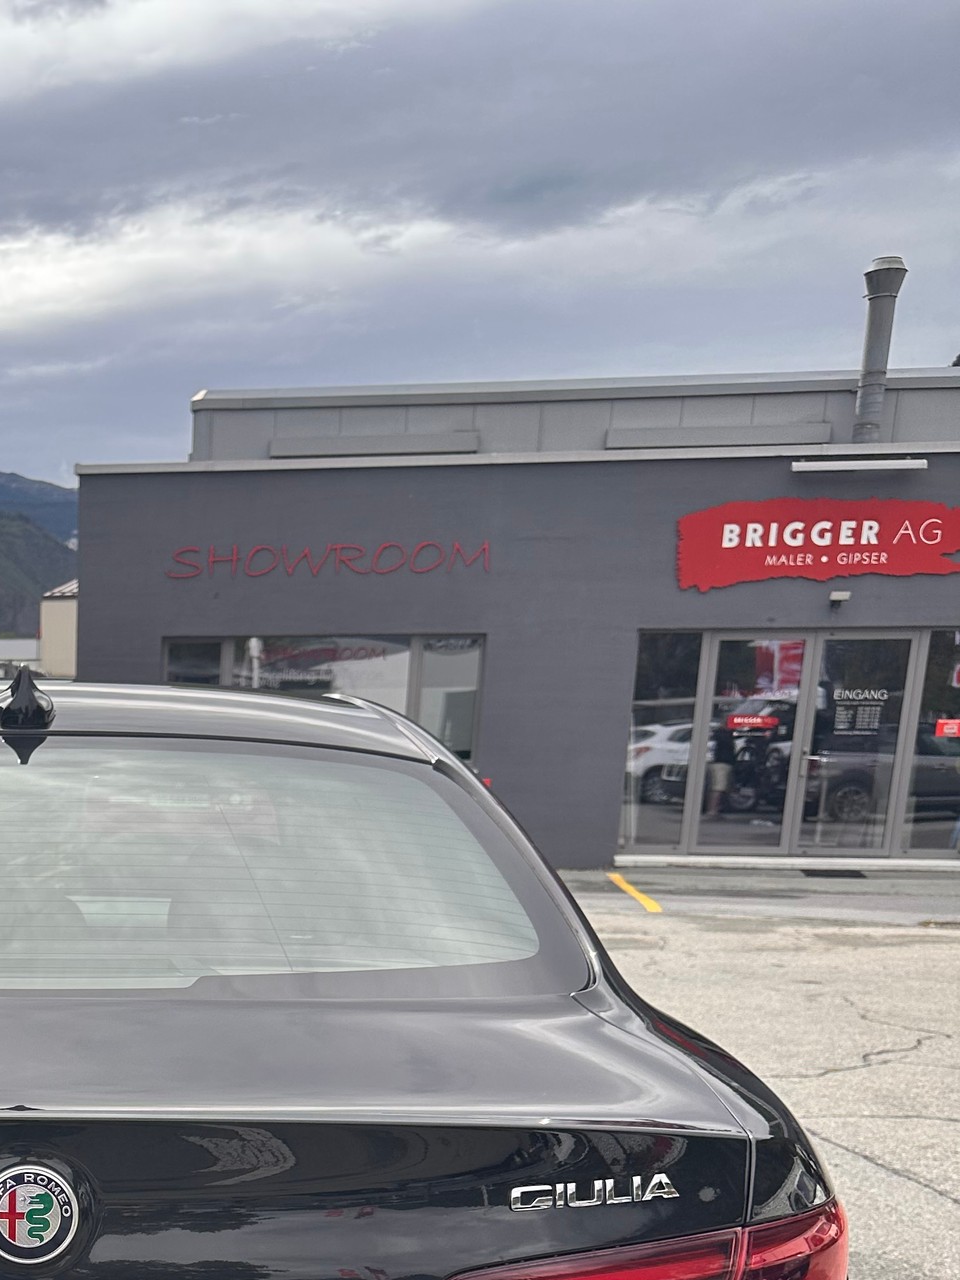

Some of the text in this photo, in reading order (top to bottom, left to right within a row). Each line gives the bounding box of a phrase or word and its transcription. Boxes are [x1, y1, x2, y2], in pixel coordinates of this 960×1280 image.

[722, 518, 942, 548] BRIGGER AG
[165, 540, 490, 578] SHOWROOM
[764, 552, 888, 566] MALER GIPSER
[833, 688, 888, 700] EINGANG
[24, 1173, 71, 1218] ROMEO
[510, 1172, 680, 1212] GIULIA
